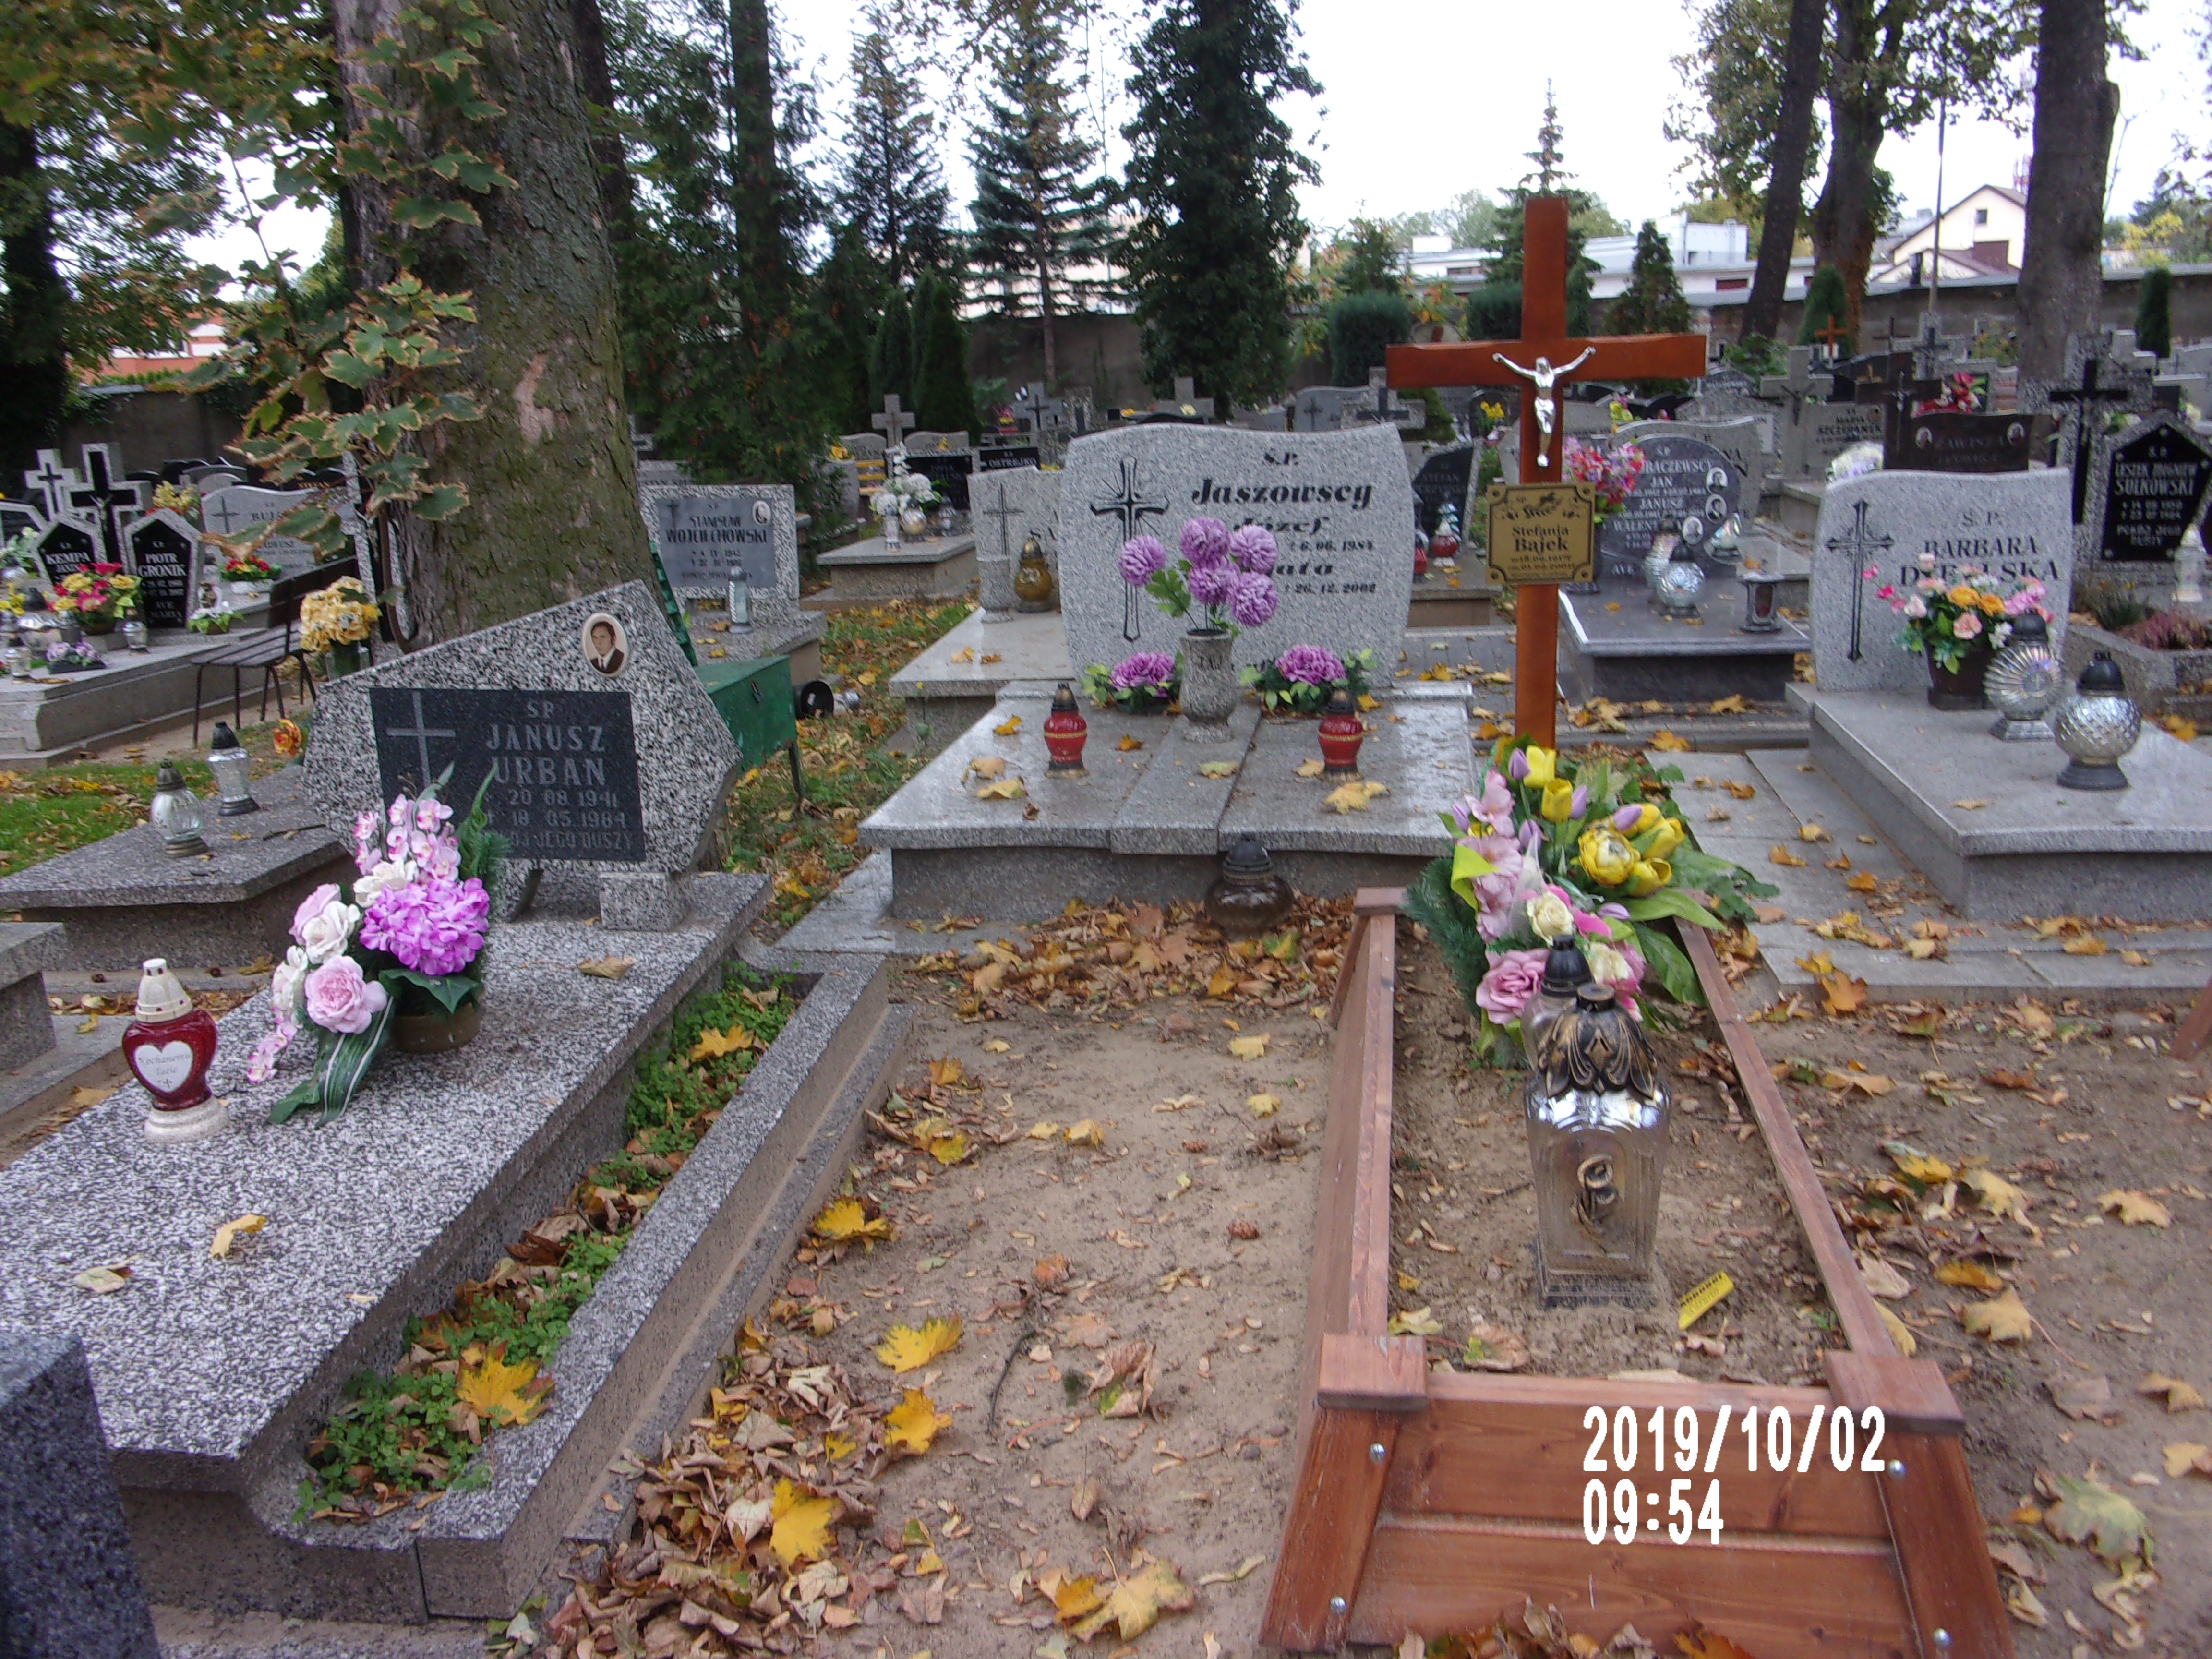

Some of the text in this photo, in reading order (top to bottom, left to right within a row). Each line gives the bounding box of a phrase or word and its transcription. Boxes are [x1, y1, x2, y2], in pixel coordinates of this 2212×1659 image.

[1191, 477, 1373, 510] Jaszowscy
[1512, 524, 1570, 538] Stefania
[1514, 536, 1570, 555] Bajek
[1924, 534, 2038, 558] BARBARA
[486, 723, 605, 753] JANUSZ
[491, 756, 607, 786] URBAN
[509, 789, 532, 806] 20
[535, 830, 577, 849] JEGO
[582, 830, 632, 850] DUSZY
